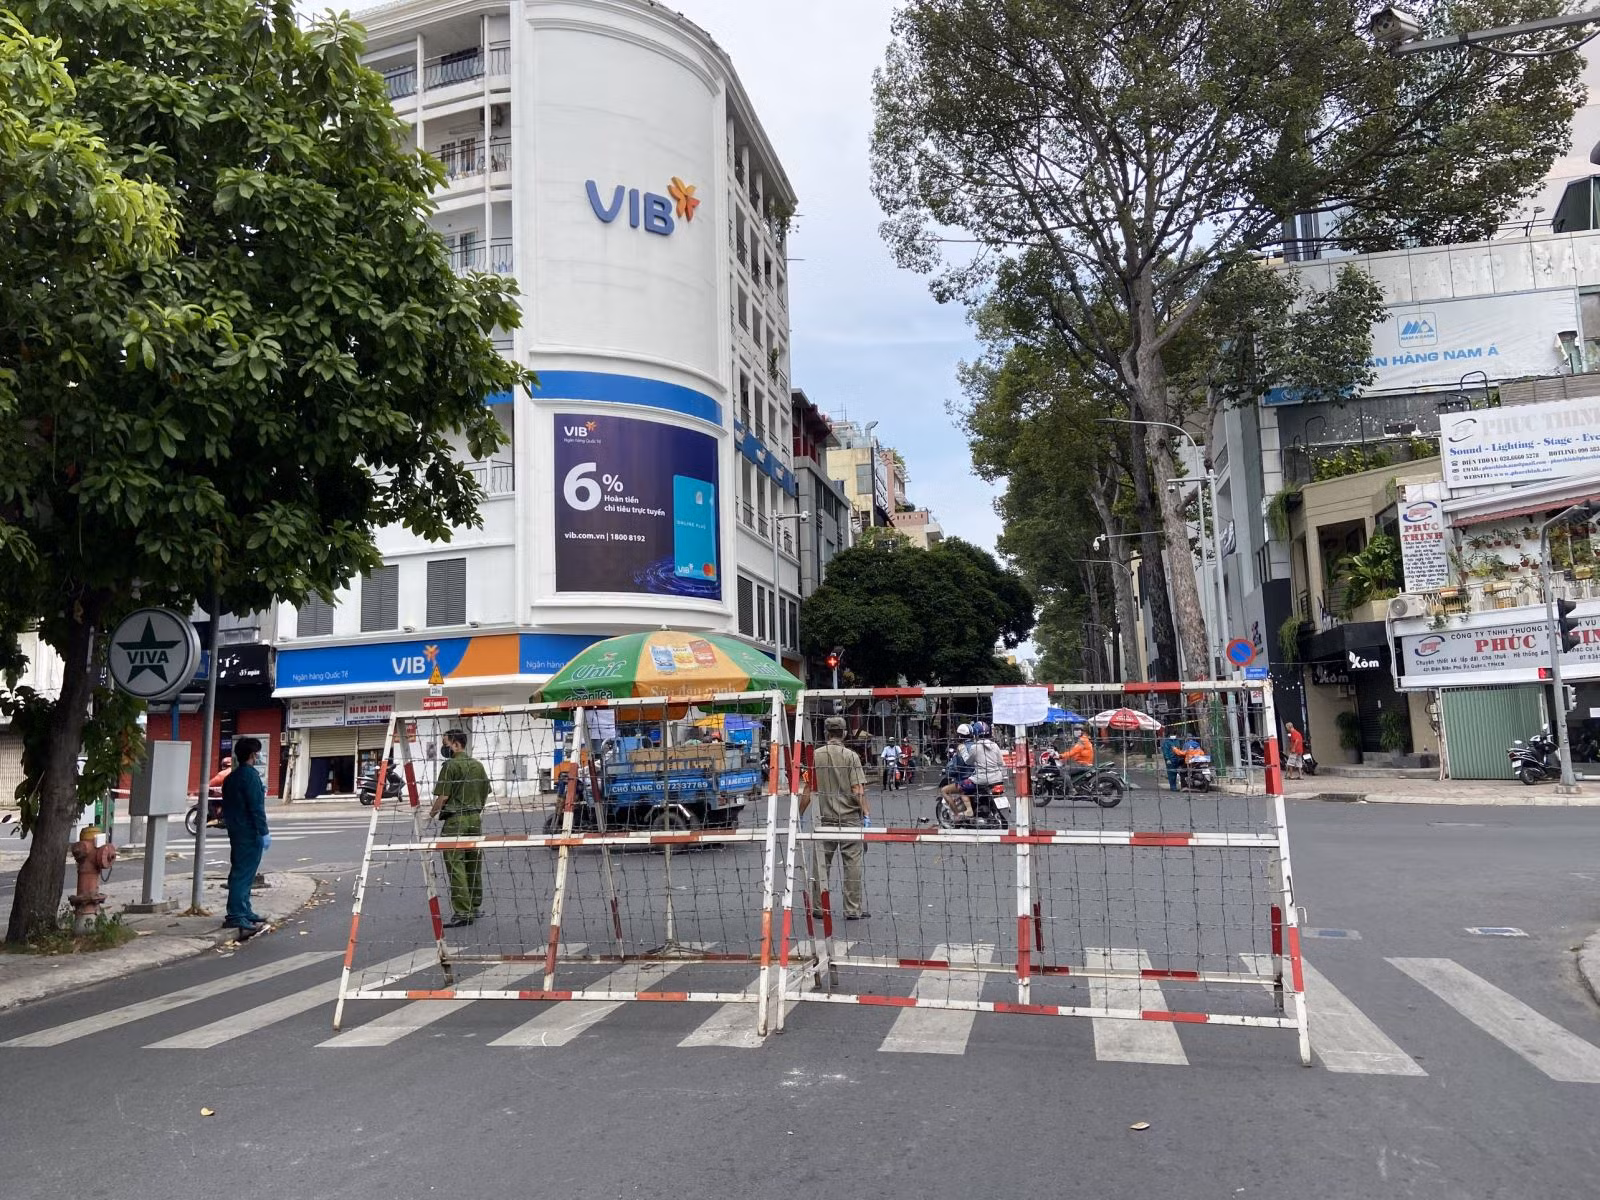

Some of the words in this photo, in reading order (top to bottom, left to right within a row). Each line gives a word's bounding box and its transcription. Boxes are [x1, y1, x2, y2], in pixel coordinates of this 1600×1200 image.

[585, 179, 675, 235] VIB
[1392, 351, 1438, 366] HÀNG
[1444, 347, 1482, 360] NAM
[1487, 343, 1499, 356] Á
[564, 426, 588, 437] VIB
[1450, 445, 1482, 456] Sound
[1492, 440, 1534, 452] Lighting
[1544, 436, 1572, 446] Stage
[616, 505, 630, 513] tiêu
[564, 532, 605, 540] vib.com.vn
[628, 534, 646, 542] 8192
[1450, 632, 1472, 640] CÔNG
[1475, 634, 1536, 653] PHÚC
[127, 650, 169, 664] VIVA
[392, 656, 426, 674] VIB
[526, 660, 546, 669] Ngân
[572, 660, 627, 680] Unif
[324, 671, 340, 679] Quốc
[341, 670, 348, 678] Tế
